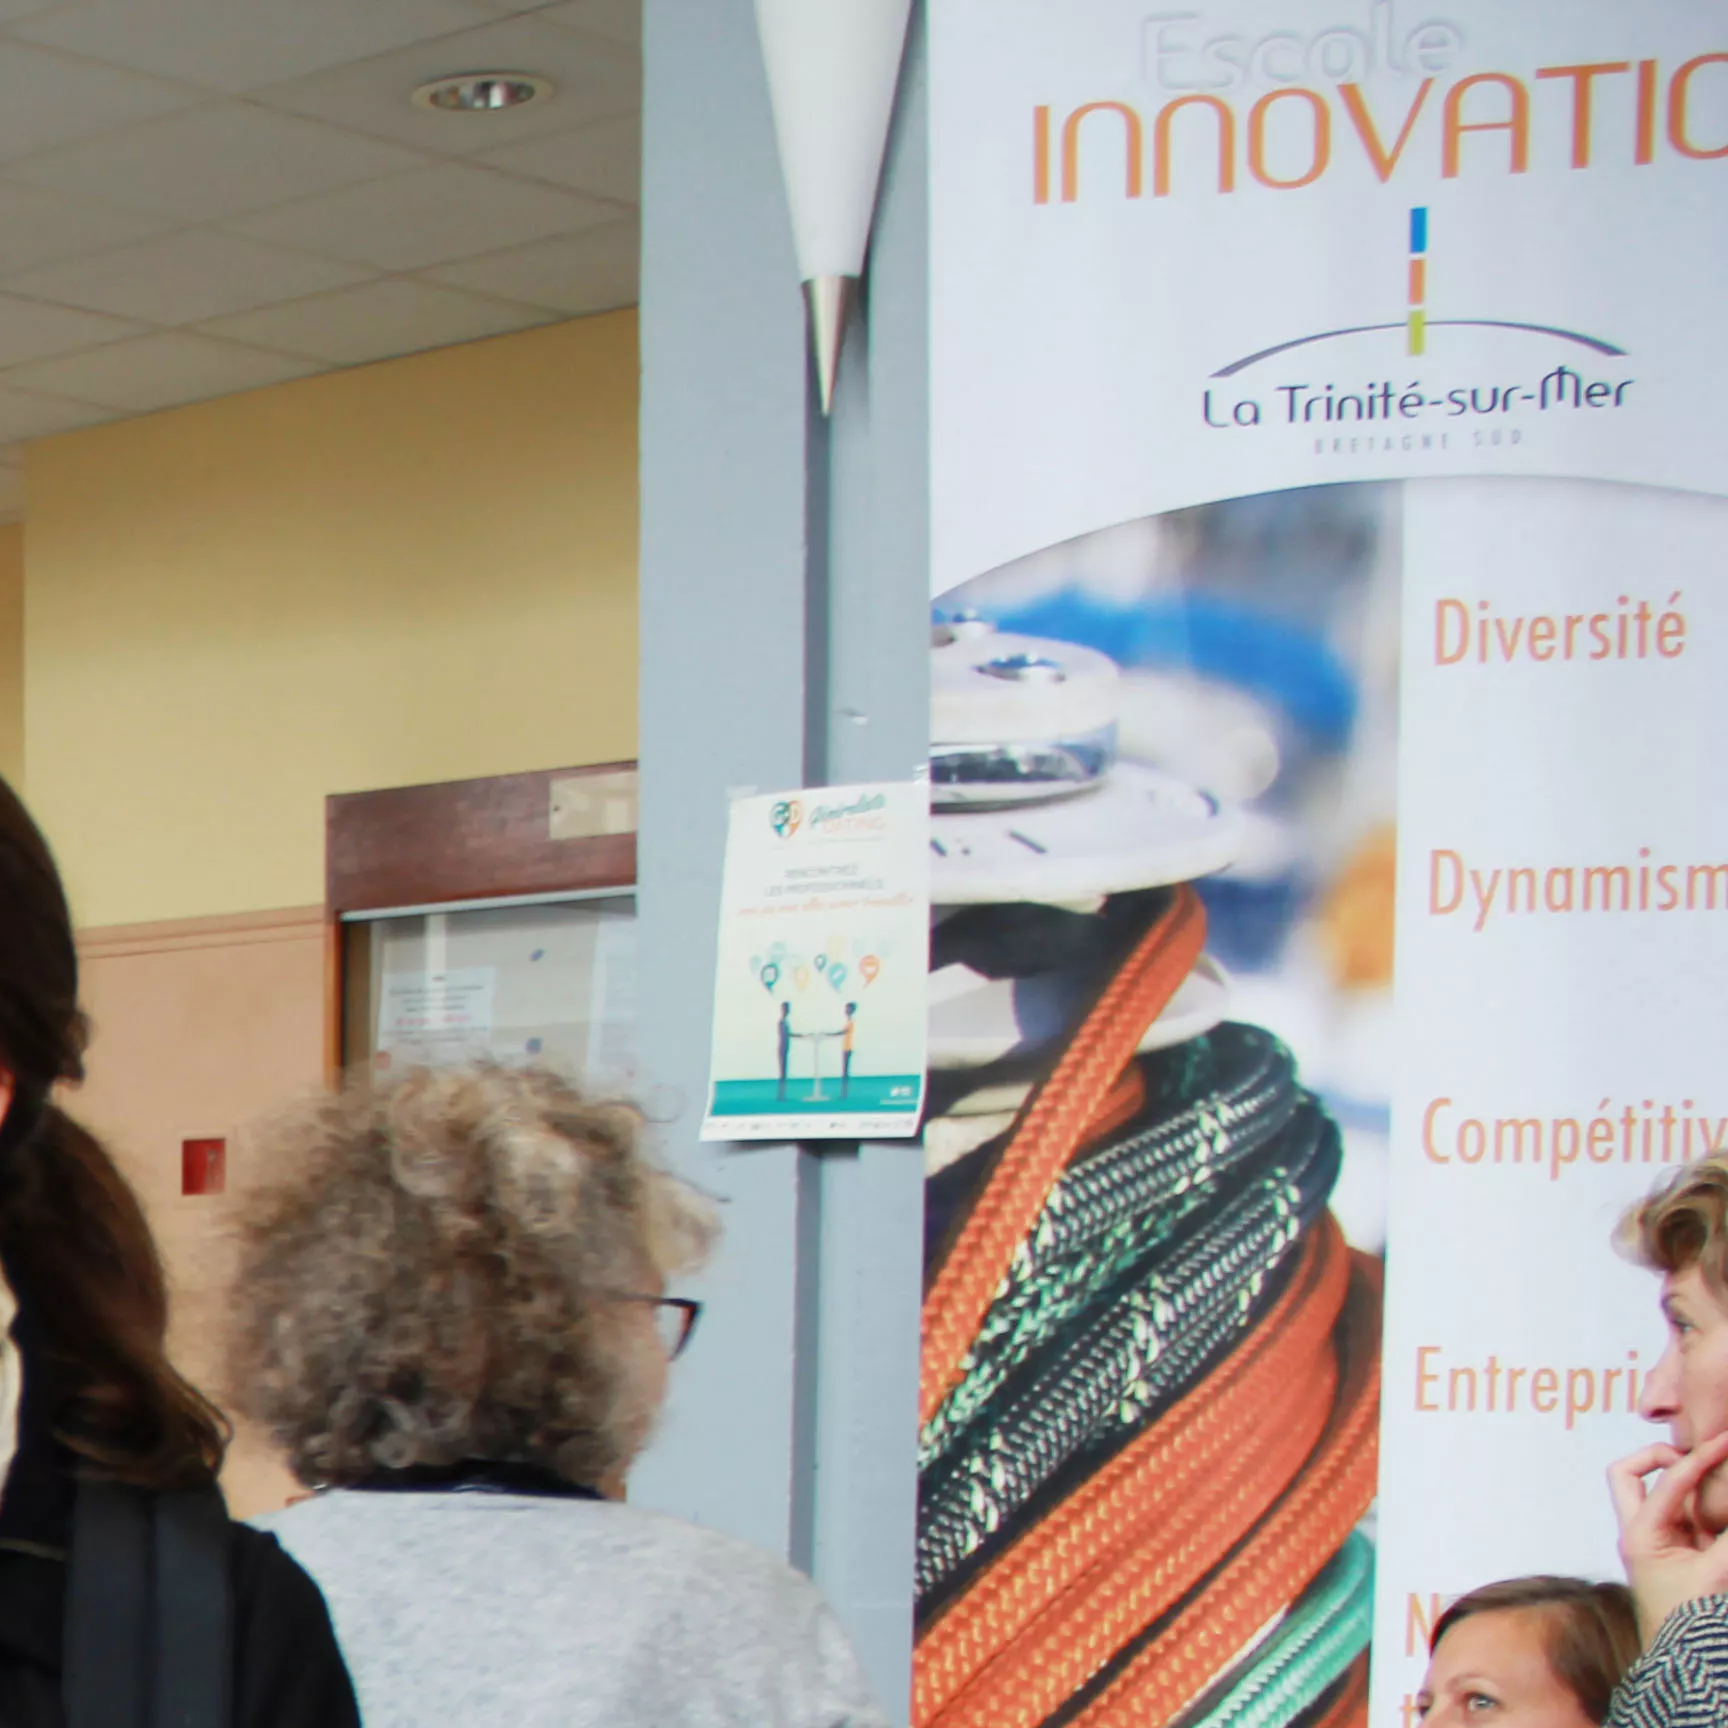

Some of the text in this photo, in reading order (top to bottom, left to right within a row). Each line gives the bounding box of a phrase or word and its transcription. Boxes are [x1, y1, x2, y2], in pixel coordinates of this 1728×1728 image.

[1202, 365, 1636, 429] La Trinité-sur-Mer
[1314, 428, 1524, 455] BRETAGNE SUD
[1434, 590, 1686, 666] Diversité
[1429, 847, 1728, 933] Dynamism
[1421, 1096, 1728, 1182] Compétitiv
[1414, 1346, 1639, 1430] Entrepri
